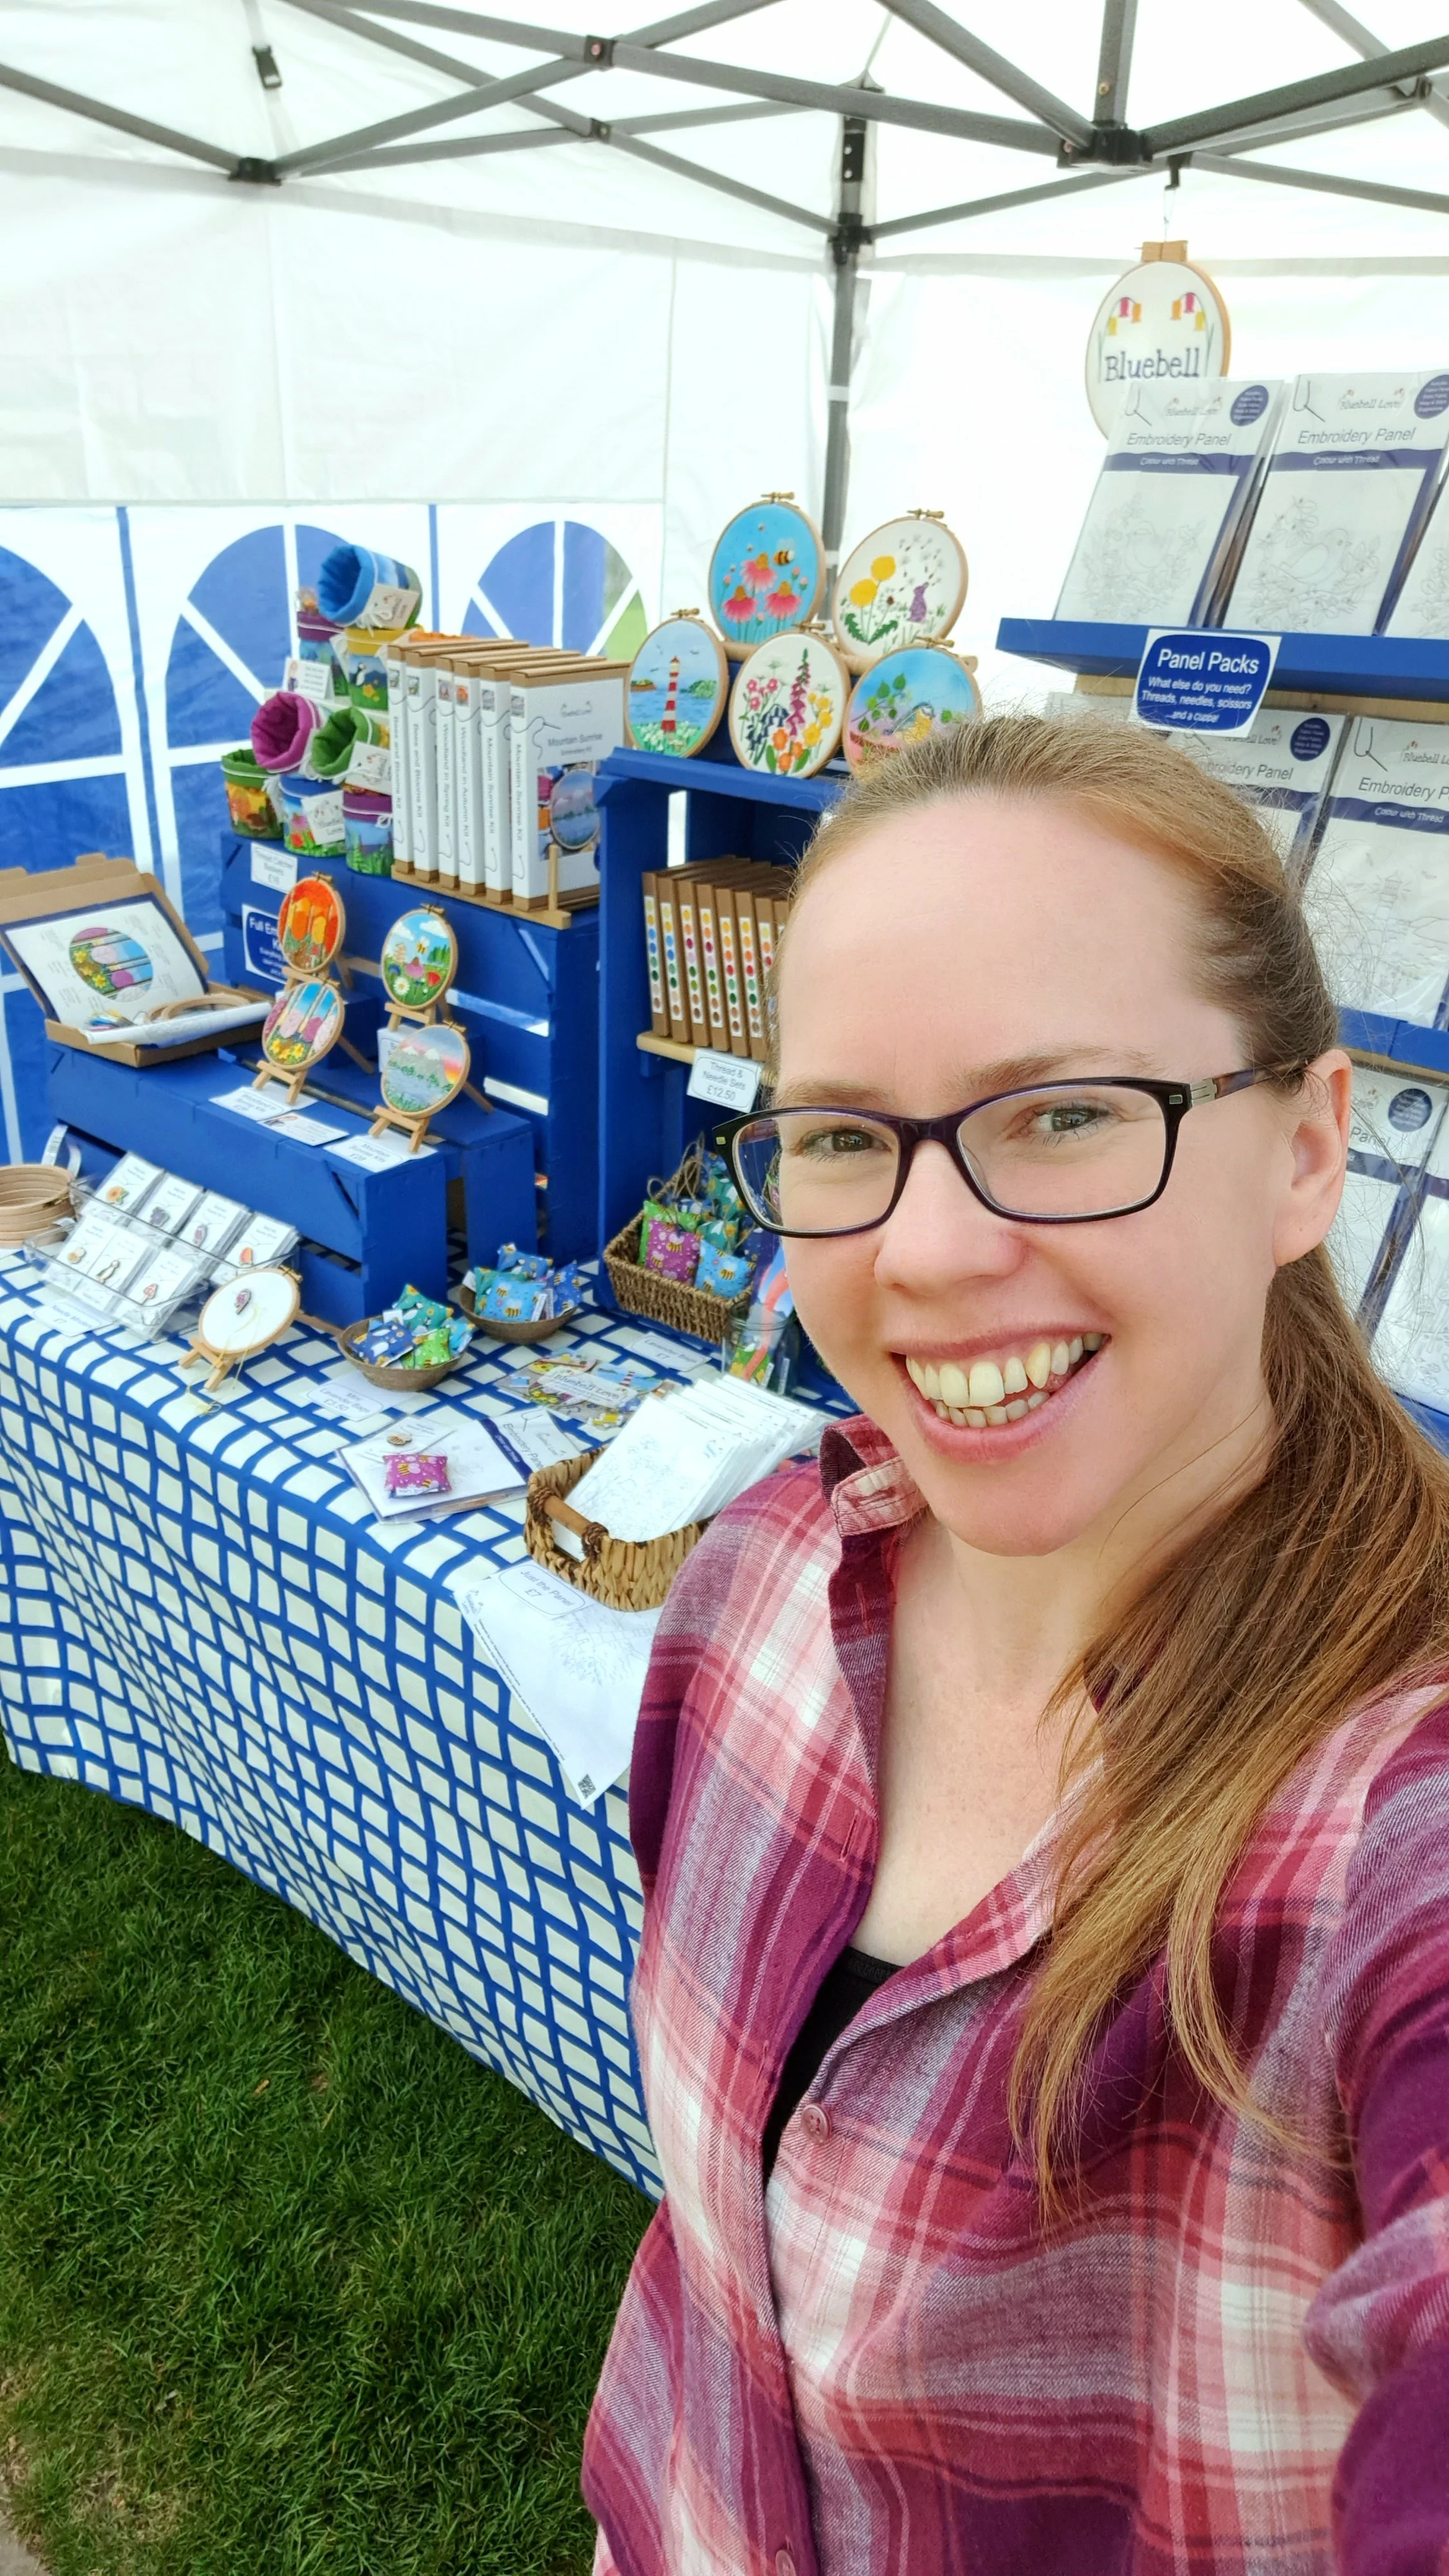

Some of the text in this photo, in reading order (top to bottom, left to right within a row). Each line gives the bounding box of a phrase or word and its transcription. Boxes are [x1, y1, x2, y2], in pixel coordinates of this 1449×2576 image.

[1106, 348, 1199, 382] Bluebell
[1127, 432, 1231, 448] Embroidery Panel
[1298, 427, 1416, 445] Embroidery Panel
[1354, 455, 1381, 464] Thread
[1157, 648, 1260, 674] Panel Packs
[1148, 676, 1252, 695] What else do you need?
[1142, 690, 1252, 710] Threads, needles, scissors
[1403, 752, 1439, 764] Bluebell
[1256, 764, 1294, 780] Panel
[1358, 777, 1436, 802] Embroidery
[1374, 807, 1444, 823] Colour with Thread
[249, 916, 264, 932] Full
[710, 1061, 743, 1078] Thread &
[703, 1070, 746, 1090] Needle Sets
[644, 1340, 679, 1355] Lavender
[554, 1374, 595, 1391] Bluebell
[595, 1388, 620, 1399] Love
[319, 1388, 372, 1414] Lavender Bags
[502, 1423, 531, 1454] Embroidery
[520, 1571, 575, 1606] Just the Panel
[525, 1588, 542, 1597] £7
